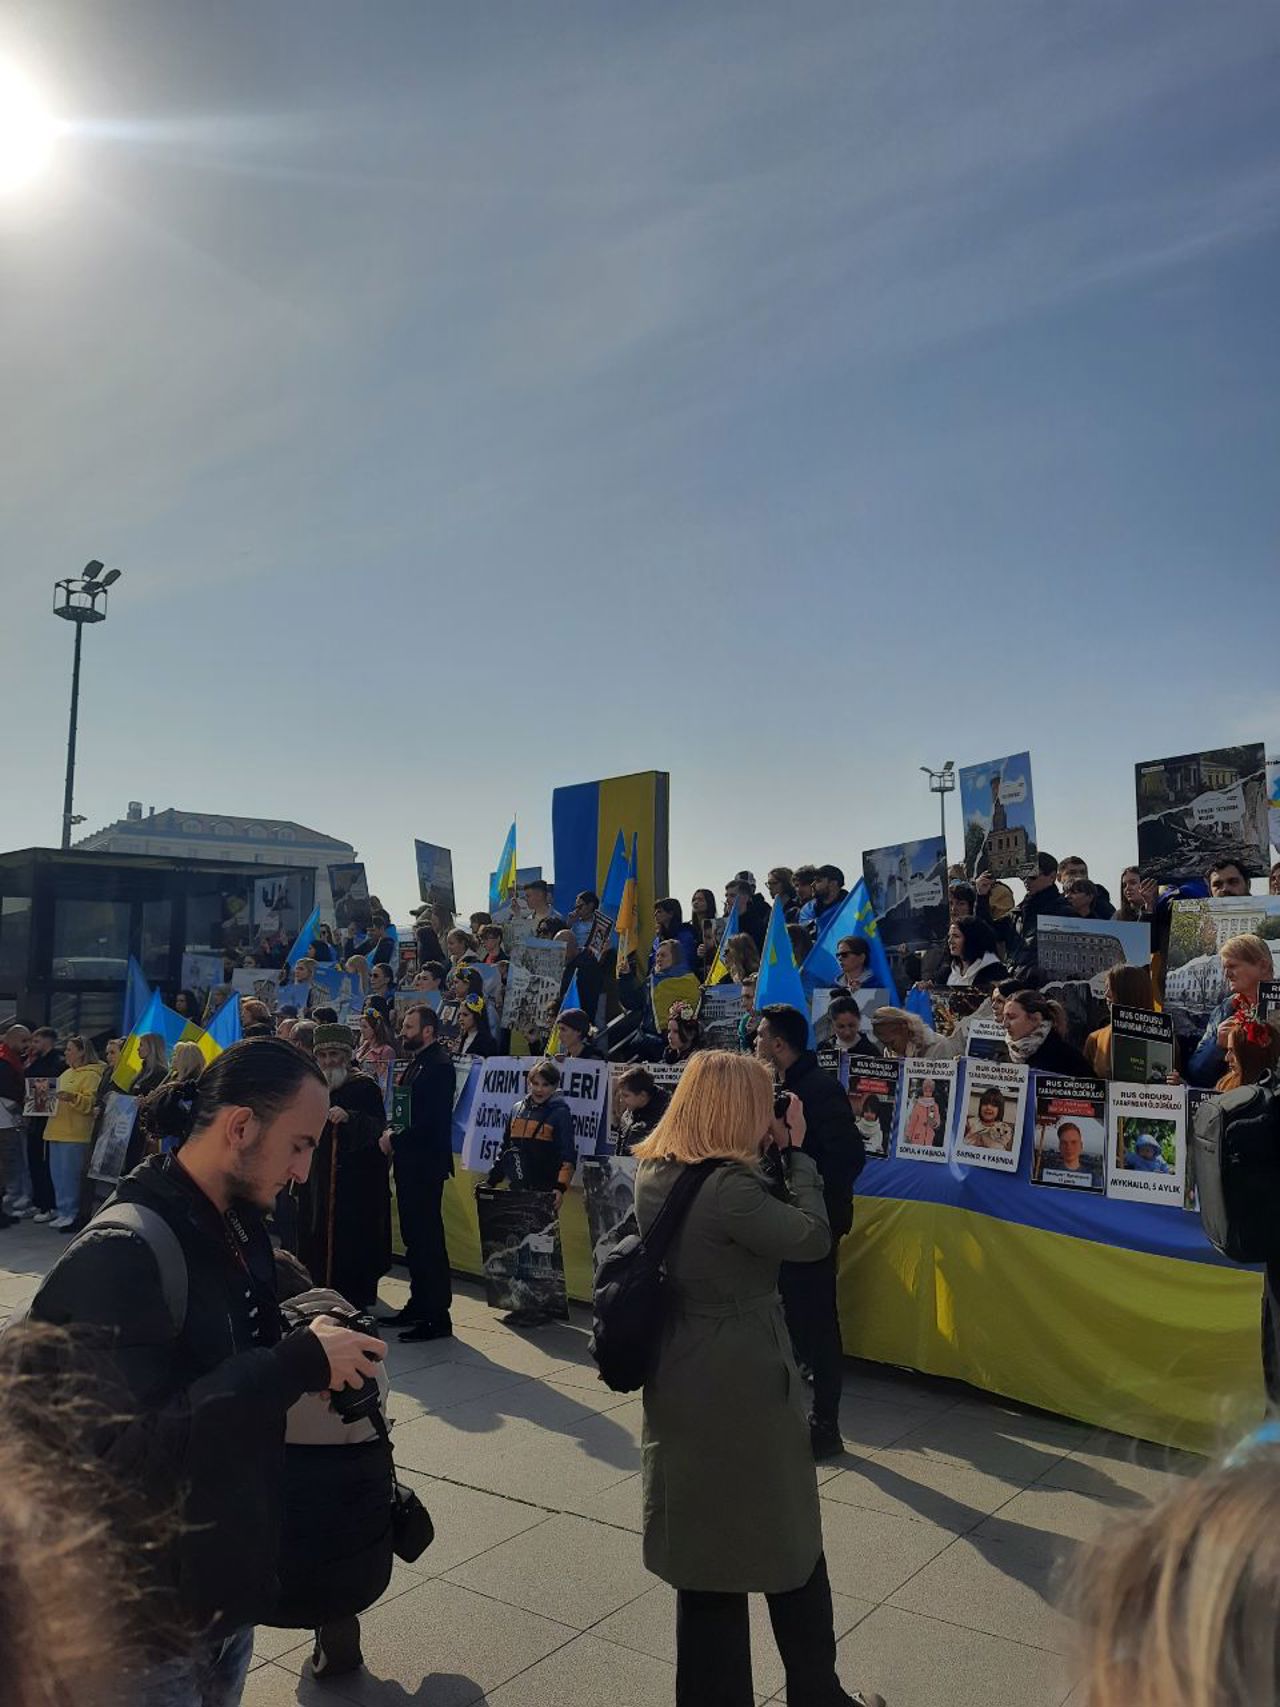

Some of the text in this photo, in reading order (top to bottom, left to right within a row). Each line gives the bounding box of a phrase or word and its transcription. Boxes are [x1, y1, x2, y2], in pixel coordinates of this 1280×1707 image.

[1119, 1011, 1133, 1020] RUS
[482, 1070, 520, 1094] KIRIM
[1046, 1080, 1096, 1090] RUS ORDUSU
[1120, 1091, 1173, 1101] RUS ORDUSU
[1158, 1184, 1181, 1194] AYLIK
[227, 1209, 249, 1243] Canon
